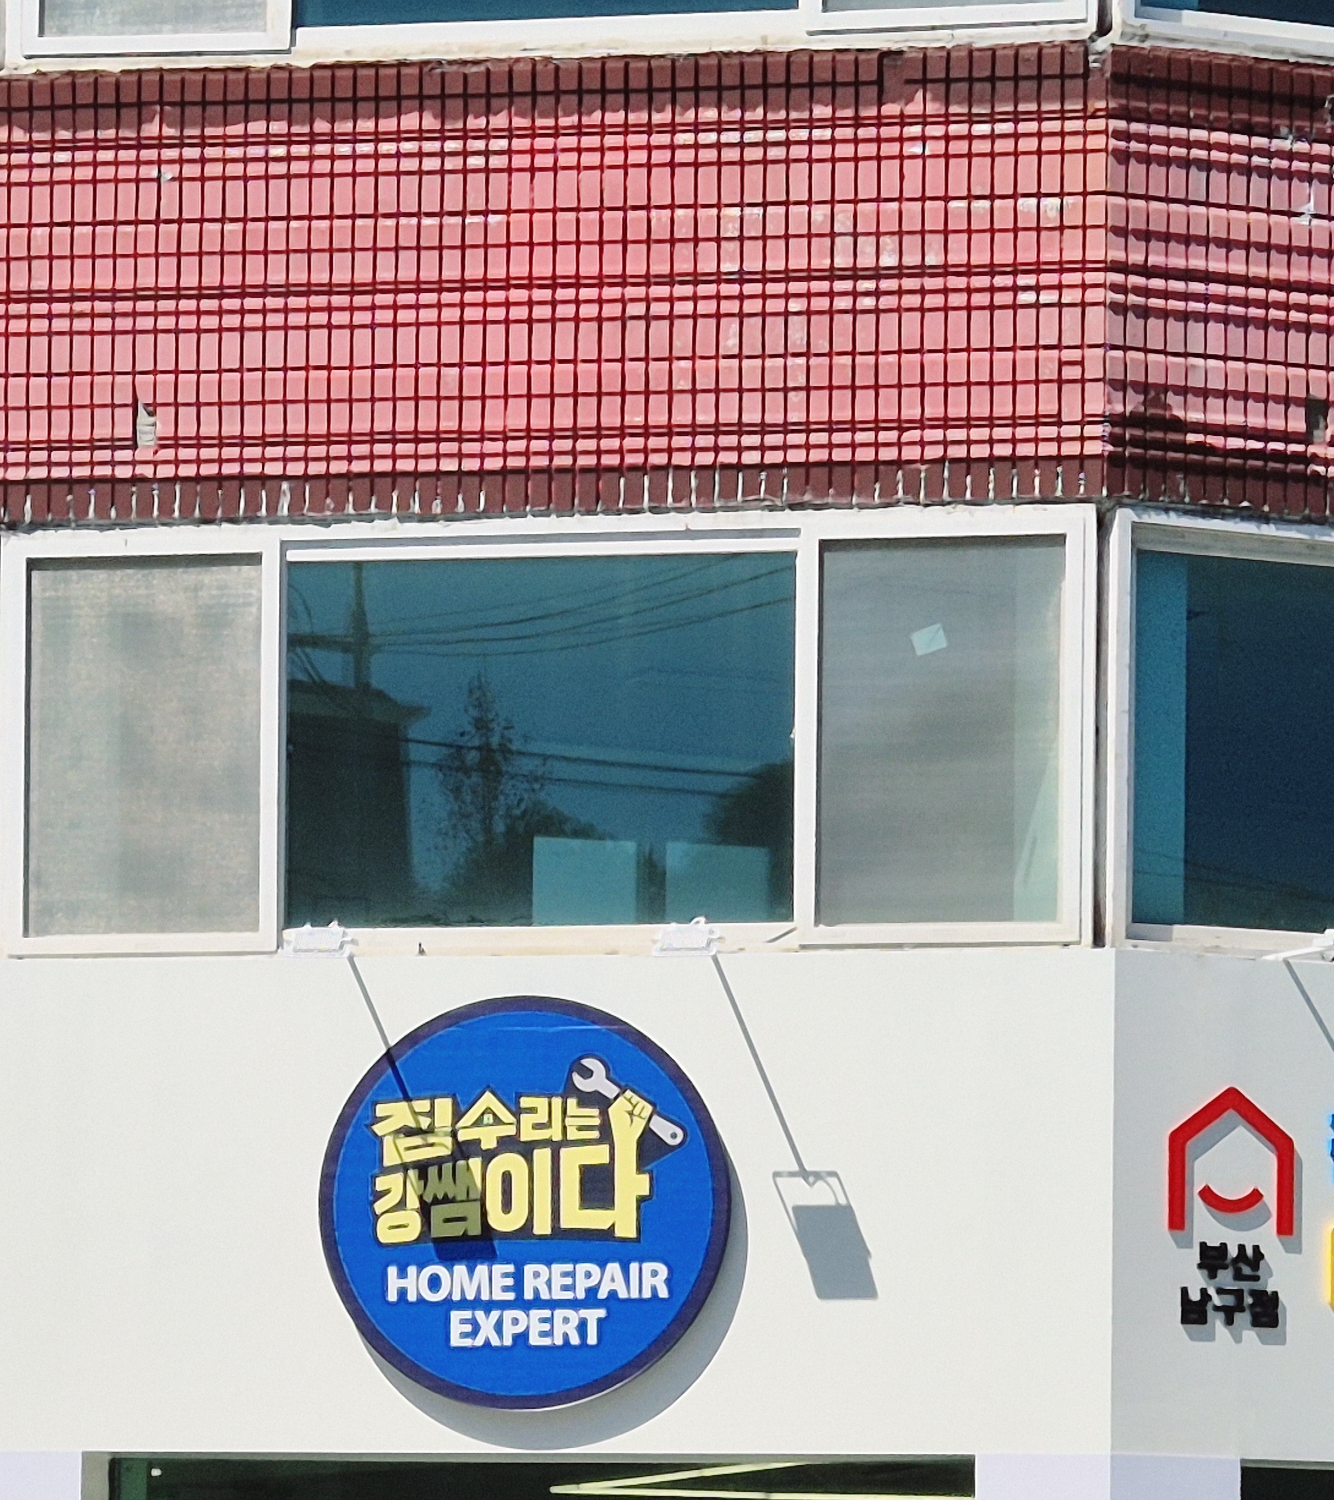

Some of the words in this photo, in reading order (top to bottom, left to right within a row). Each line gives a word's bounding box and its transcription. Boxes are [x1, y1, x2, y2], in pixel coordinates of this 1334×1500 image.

[371, 1089, 601, 1167] 집수리는
[373, 1140, 650, 1240] 강쌤이다
[385, 1262, 515, 1302] HOME
[523, 1261, 669, 1300] REPAIR
[1197, 1241, 1264, 1282] 부산
[449, 1307, 607, 1347] EXPERT
